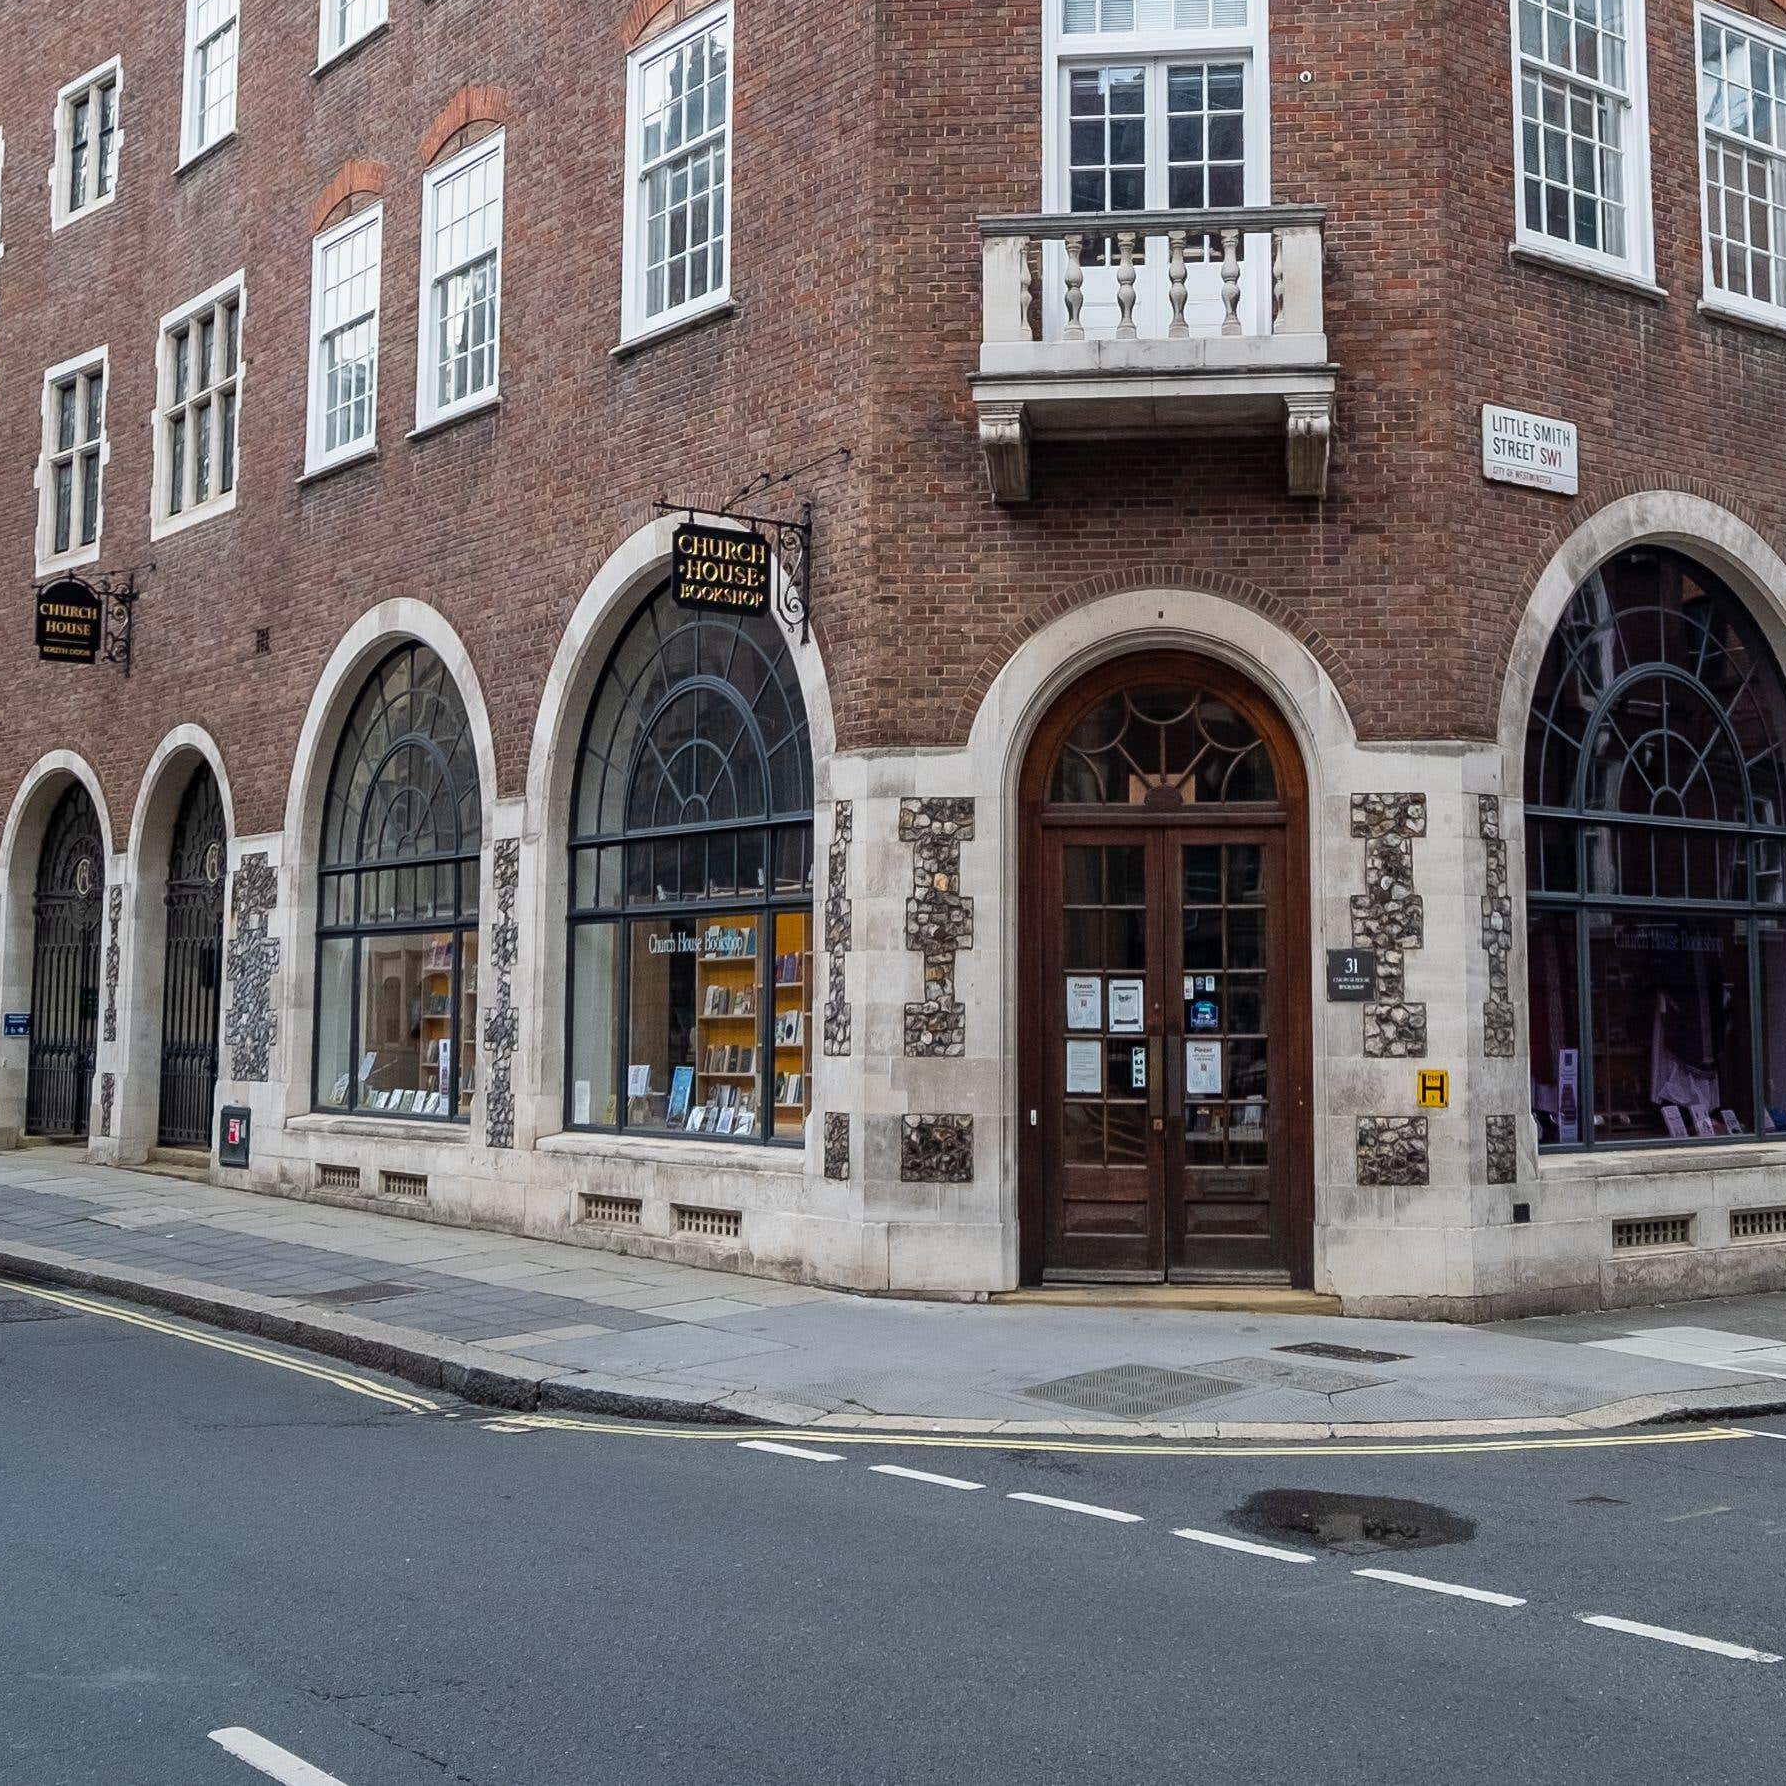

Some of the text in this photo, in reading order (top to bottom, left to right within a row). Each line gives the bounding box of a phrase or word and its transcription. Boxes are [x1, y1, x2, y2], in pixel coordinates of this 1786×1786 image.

[1492, 414, 1571, 448] LITTLE SMITH
[1493, 436, 1562, 468] STREET SW1
[1492, 466, 1505, 476] CITY
[1506, 468, 1514, 478] OF
[678, 534, 766, 564] CHURCH
[686, 559, 759, 587] HOUSE
[680, 583, 764, 608] BOOKSHOP
[39, 603, 98, 620] CHURCH
[45, 620, 92, 635] HOUSE
[648, 930, 743, 957] Church House Bookshop
[1344, 957, 1358, 974] 31
[1422, 1073, 1444, 1103] H
